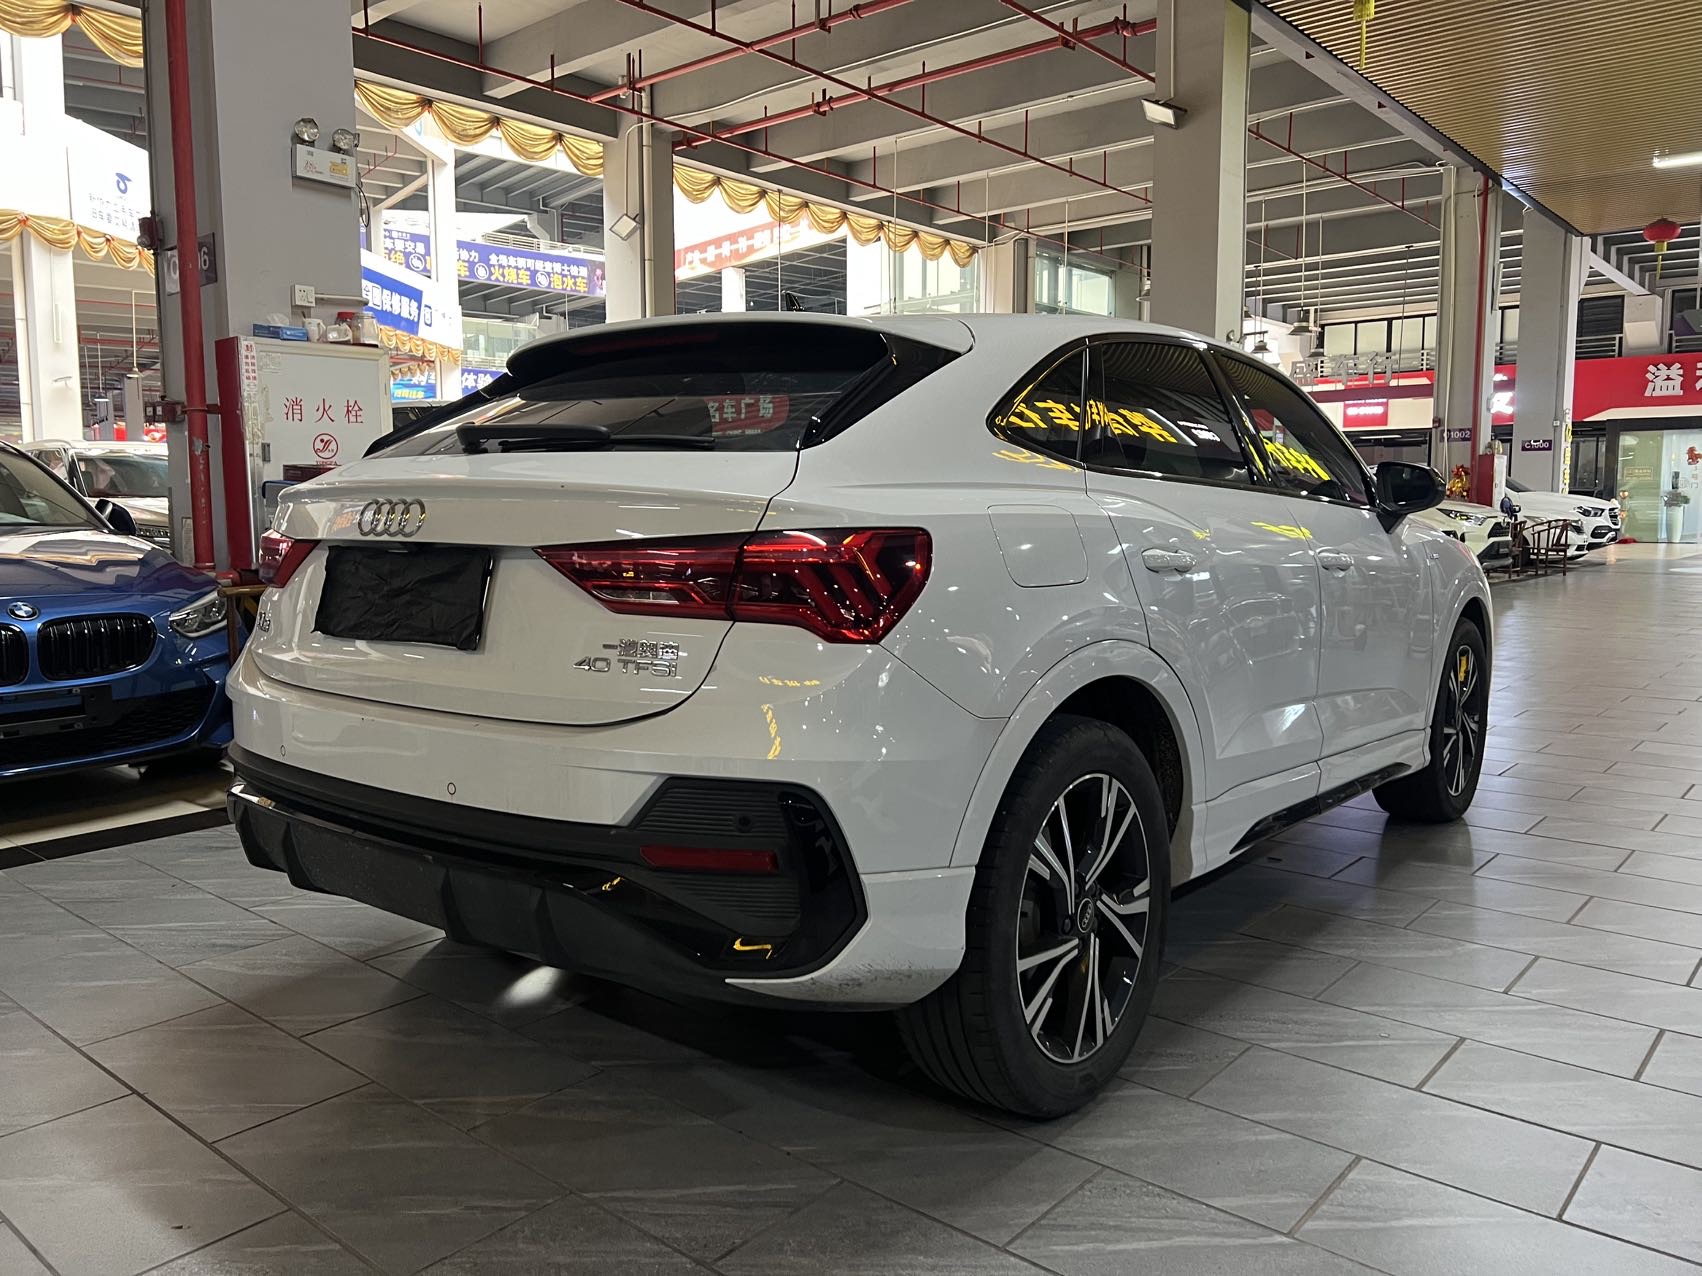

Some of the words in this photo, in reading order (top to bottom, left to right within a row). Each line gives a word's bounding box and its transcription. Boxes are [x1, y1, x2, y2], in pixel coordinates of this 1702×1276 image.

[491, 266, 531, 285] 火烧车
[551, 273, 589, 293] 泡水车
[1644, 361, 1702, 397] 溢
[284, 396, 363, 425] 消火栓
[573, 656, 612, 673] 40
